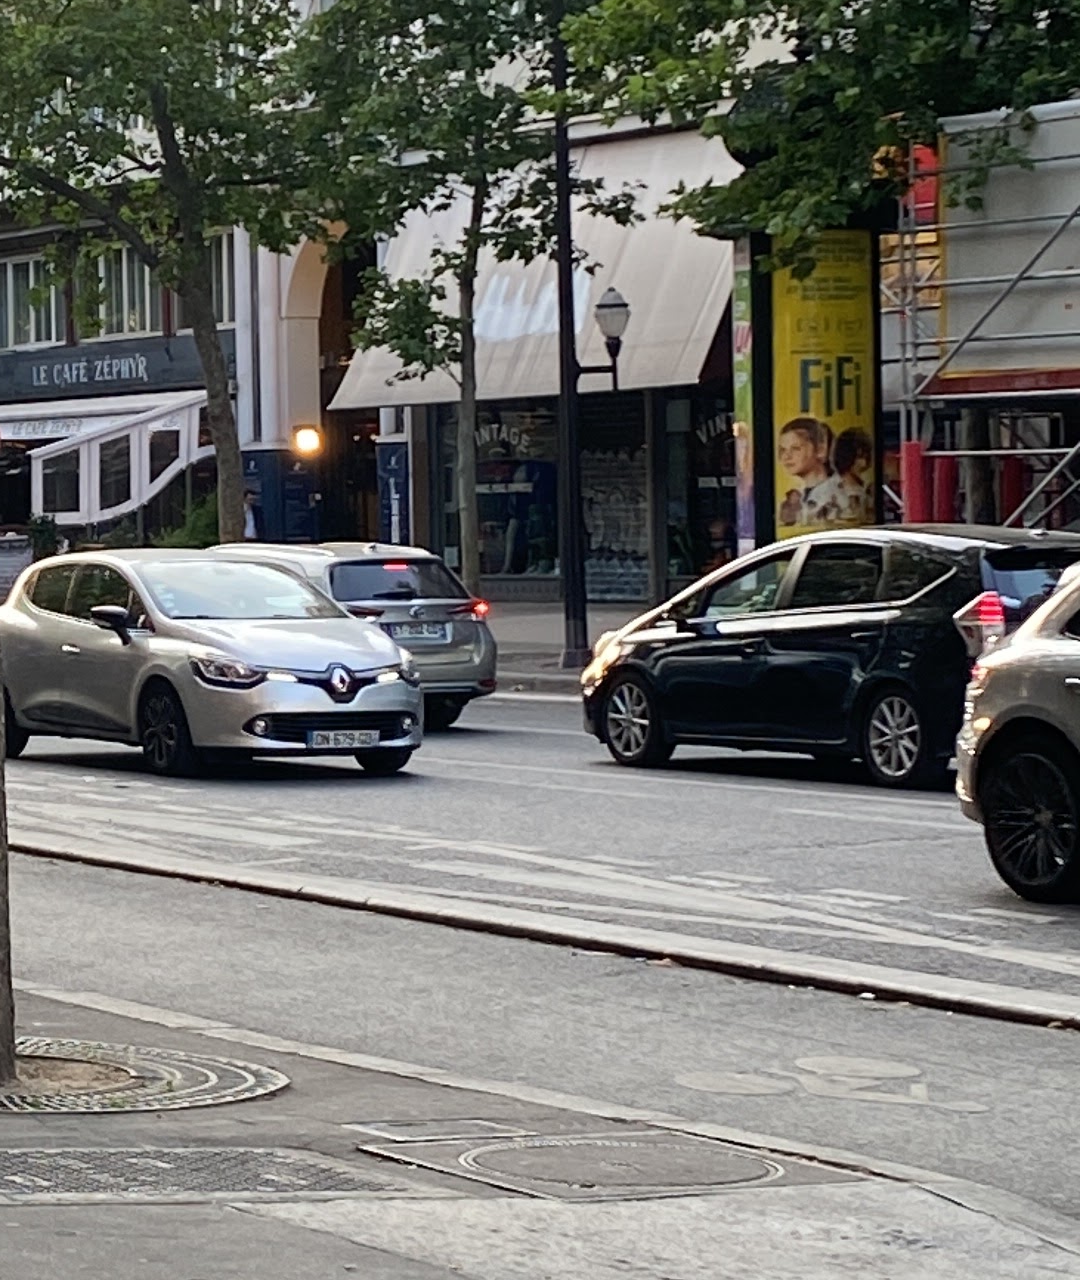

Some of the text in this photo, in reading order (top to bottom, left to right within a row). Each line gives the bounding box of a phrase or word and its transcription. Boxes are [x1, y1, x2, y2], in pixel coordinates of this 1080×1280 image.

[32, 353, 149, 388] LE CAFÉ ZÉPHYR
[800, 356, 862, 416] FiFi
[473, 423, 530, 453] INTAGE
